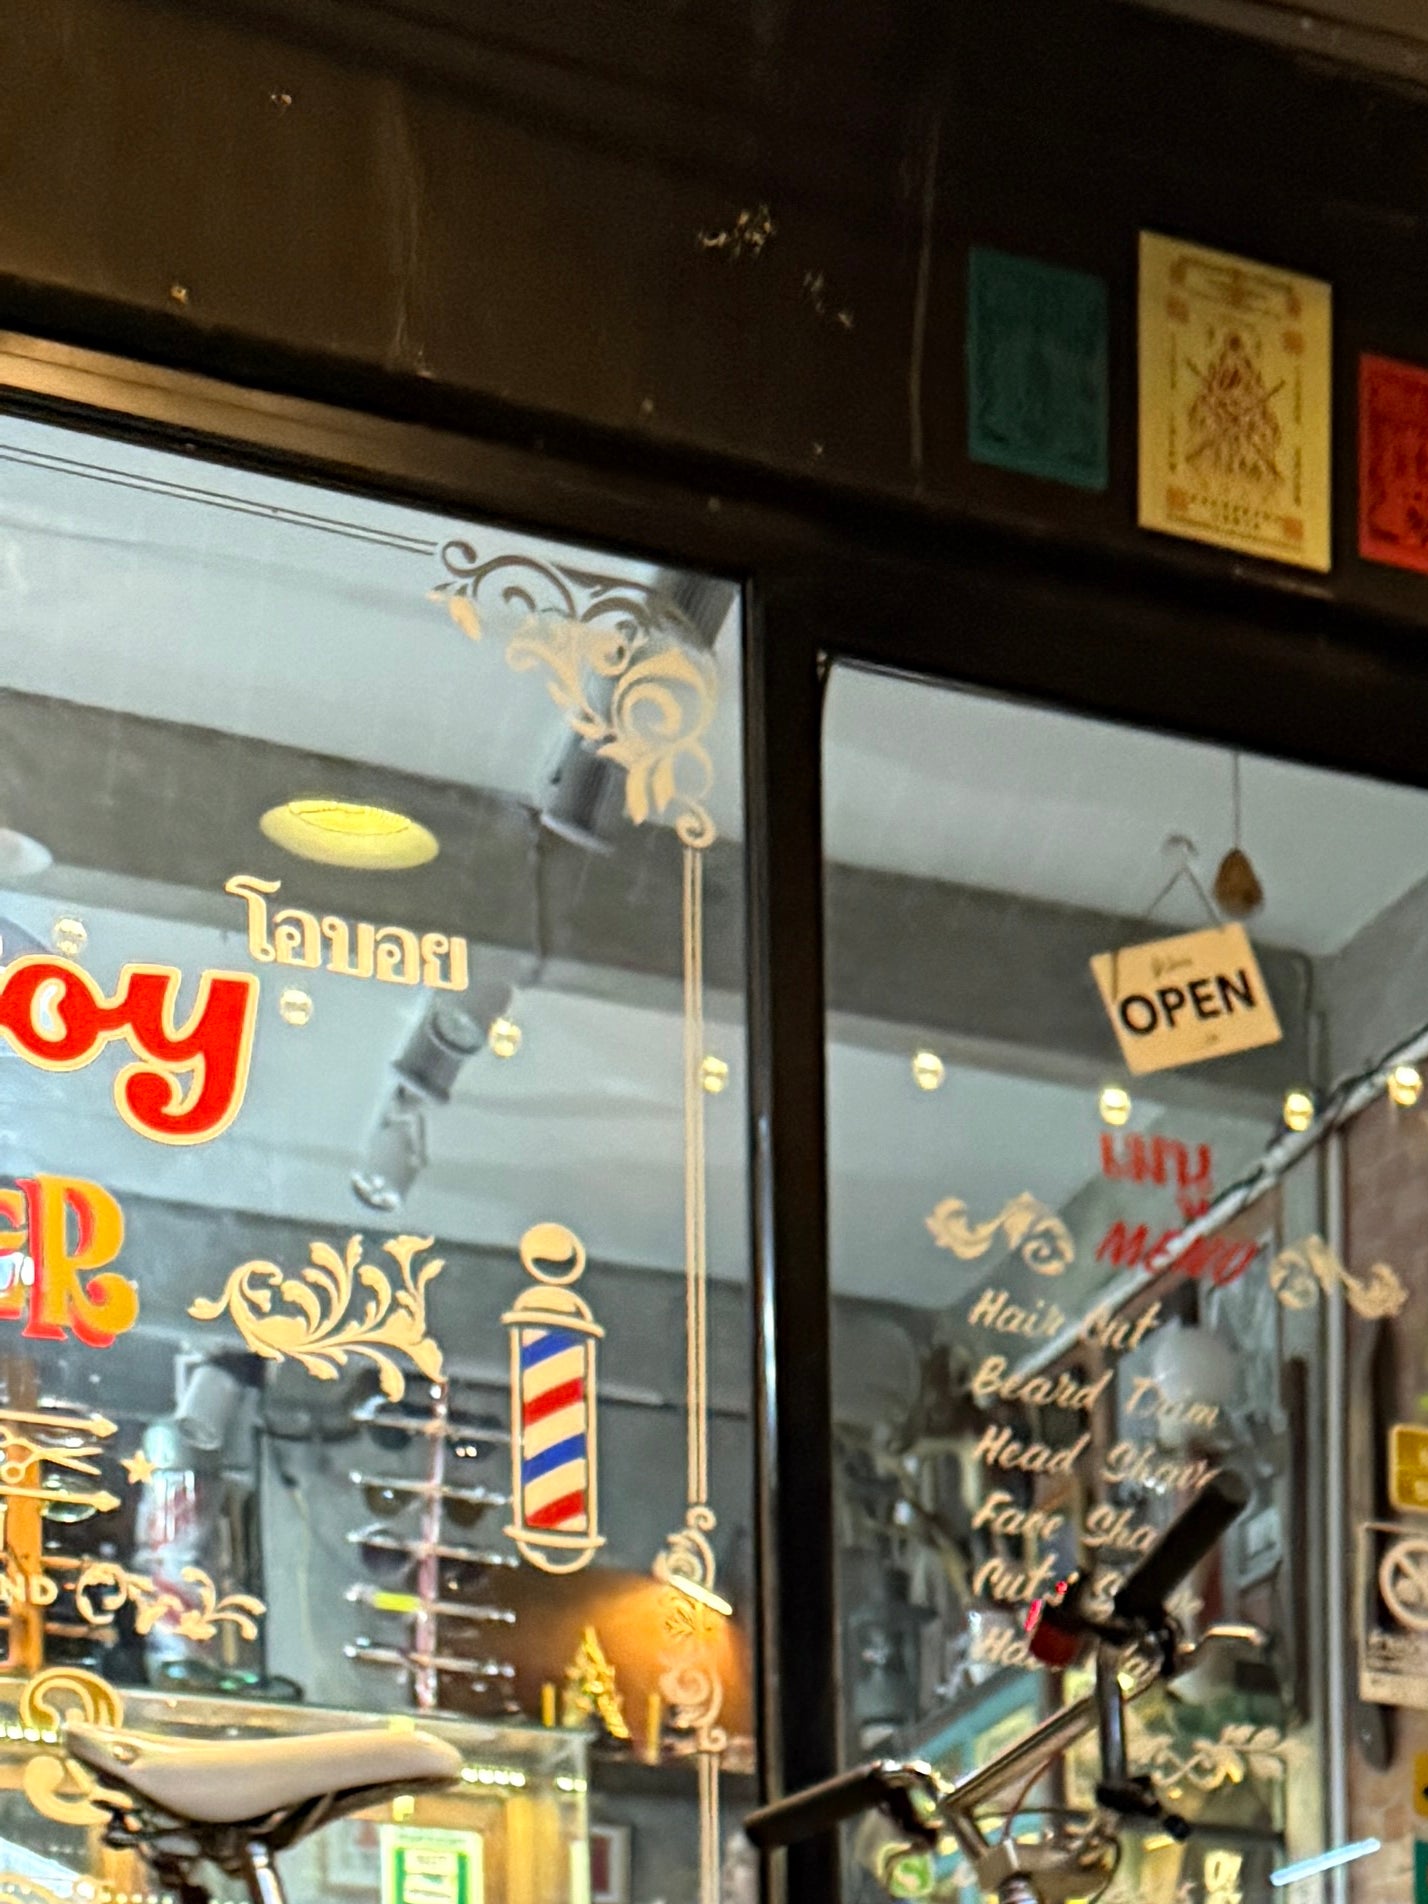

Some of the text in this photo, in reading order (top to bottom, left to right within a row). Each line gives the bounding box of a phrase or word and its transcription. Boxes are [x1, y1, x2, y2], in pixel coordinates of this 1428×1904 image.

[224, 874, 469, 992] โอบอย
[1116, 967, 1258, 1036] OPEN
[971, 1353, 1113, 1410] Beard
[971, 1423, 1092, 1475] Head
